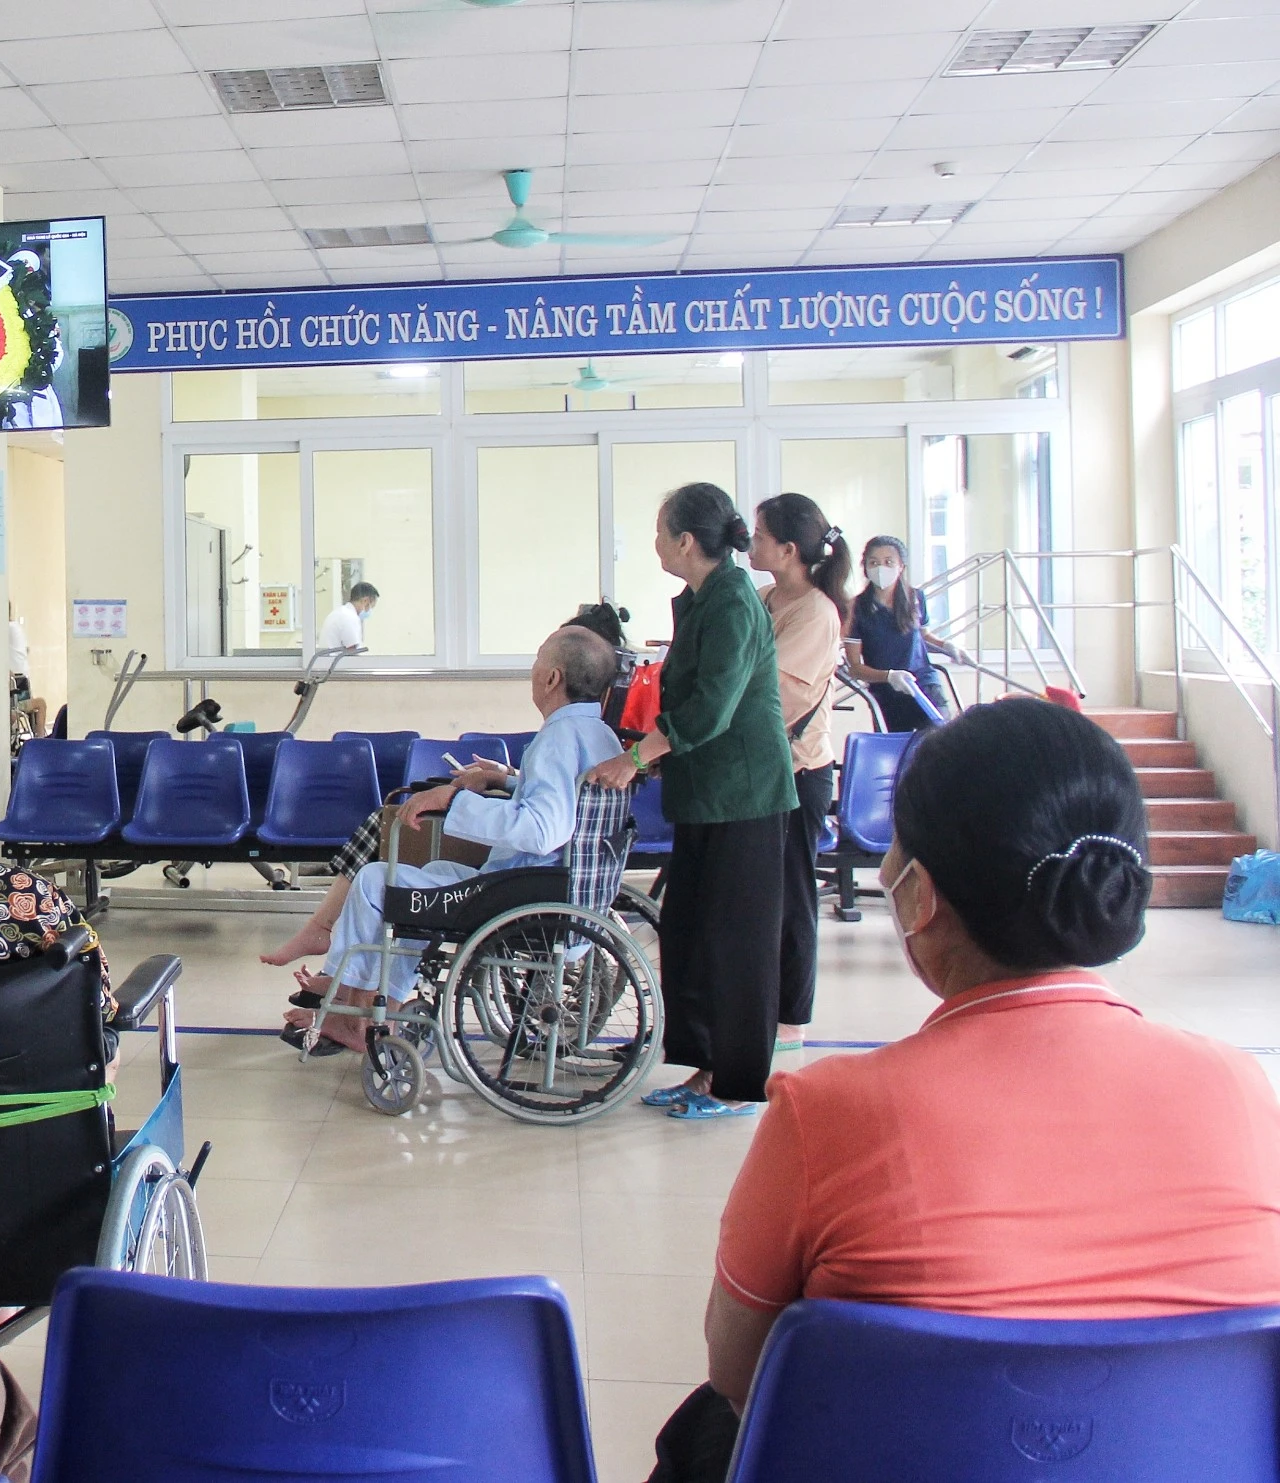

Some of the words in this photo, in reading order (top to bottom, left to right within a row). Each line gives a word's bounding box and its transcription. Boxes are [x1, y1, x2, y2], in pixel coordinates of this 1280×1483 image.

[147, 318, 227, 360] PHỤC
[235, 300, 291, 350] HỒI
[300, 304, 380, 346] CHỨC
[388, 302, 479, 344] NĂNG
[487, 324, 497, 332] -
[505, 296, 598, 340] NÂNG
[606, 284, 677, 335] TẦM
[684, 283, 770, 333] CHẤT
[779, 290, 891, 337] LƯỢNG
[898, 280, 986, 333] CUỘC
[994, 272, 1087, 323] SỐNG
[1094, 286, 1102, 320] !
[410, 890, 440, 914] BV
